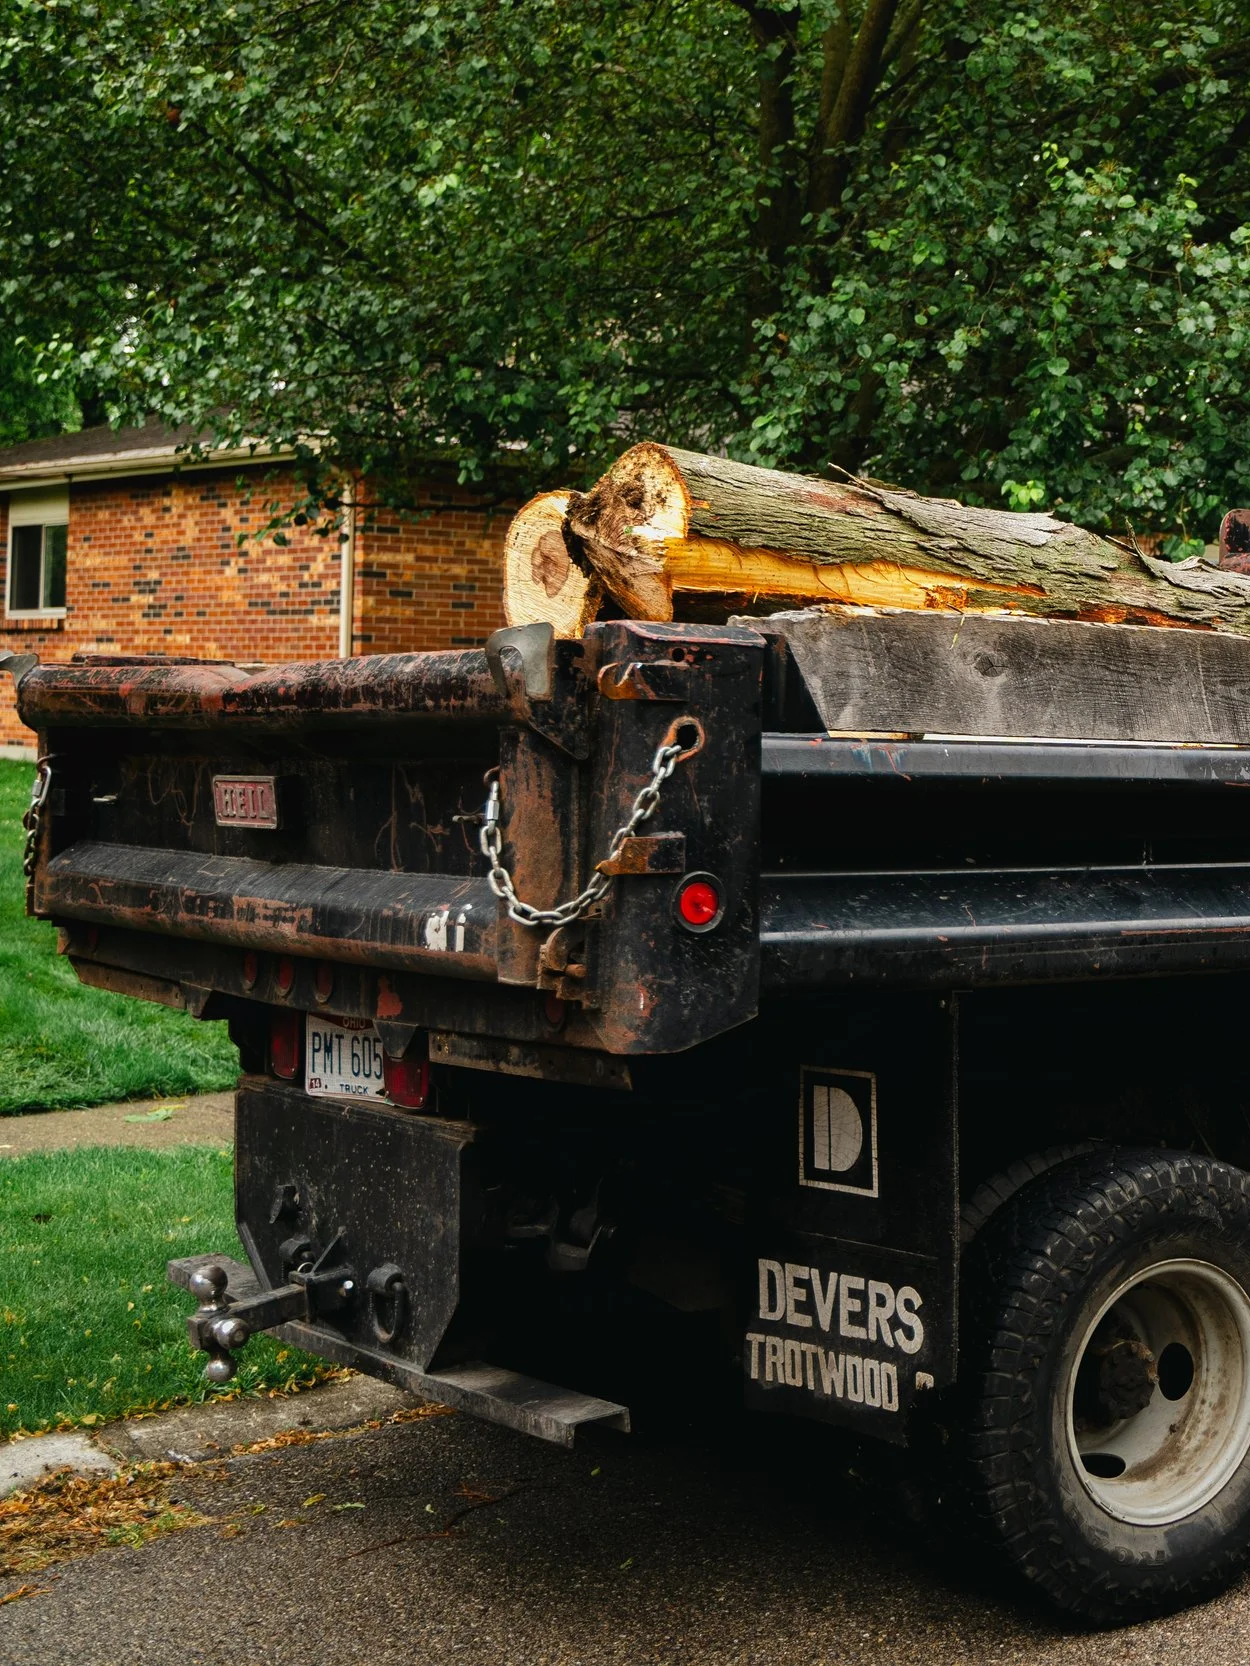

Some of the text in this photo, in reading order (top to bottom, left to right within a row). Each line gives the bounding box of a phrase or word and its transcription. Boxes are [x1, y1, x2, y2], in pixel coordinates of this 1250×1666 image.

[222, 786, 270, 819] HEIL
[342, 1016, 365, 1029] OHIO
[311, 1031, 383, 1080] PMT 605
[339, 1083, 370, 1096] TRUCK
[758, 1258, 924, 1355] DEVERS
[745, 1332, 899, 1412] TROTWOOD
